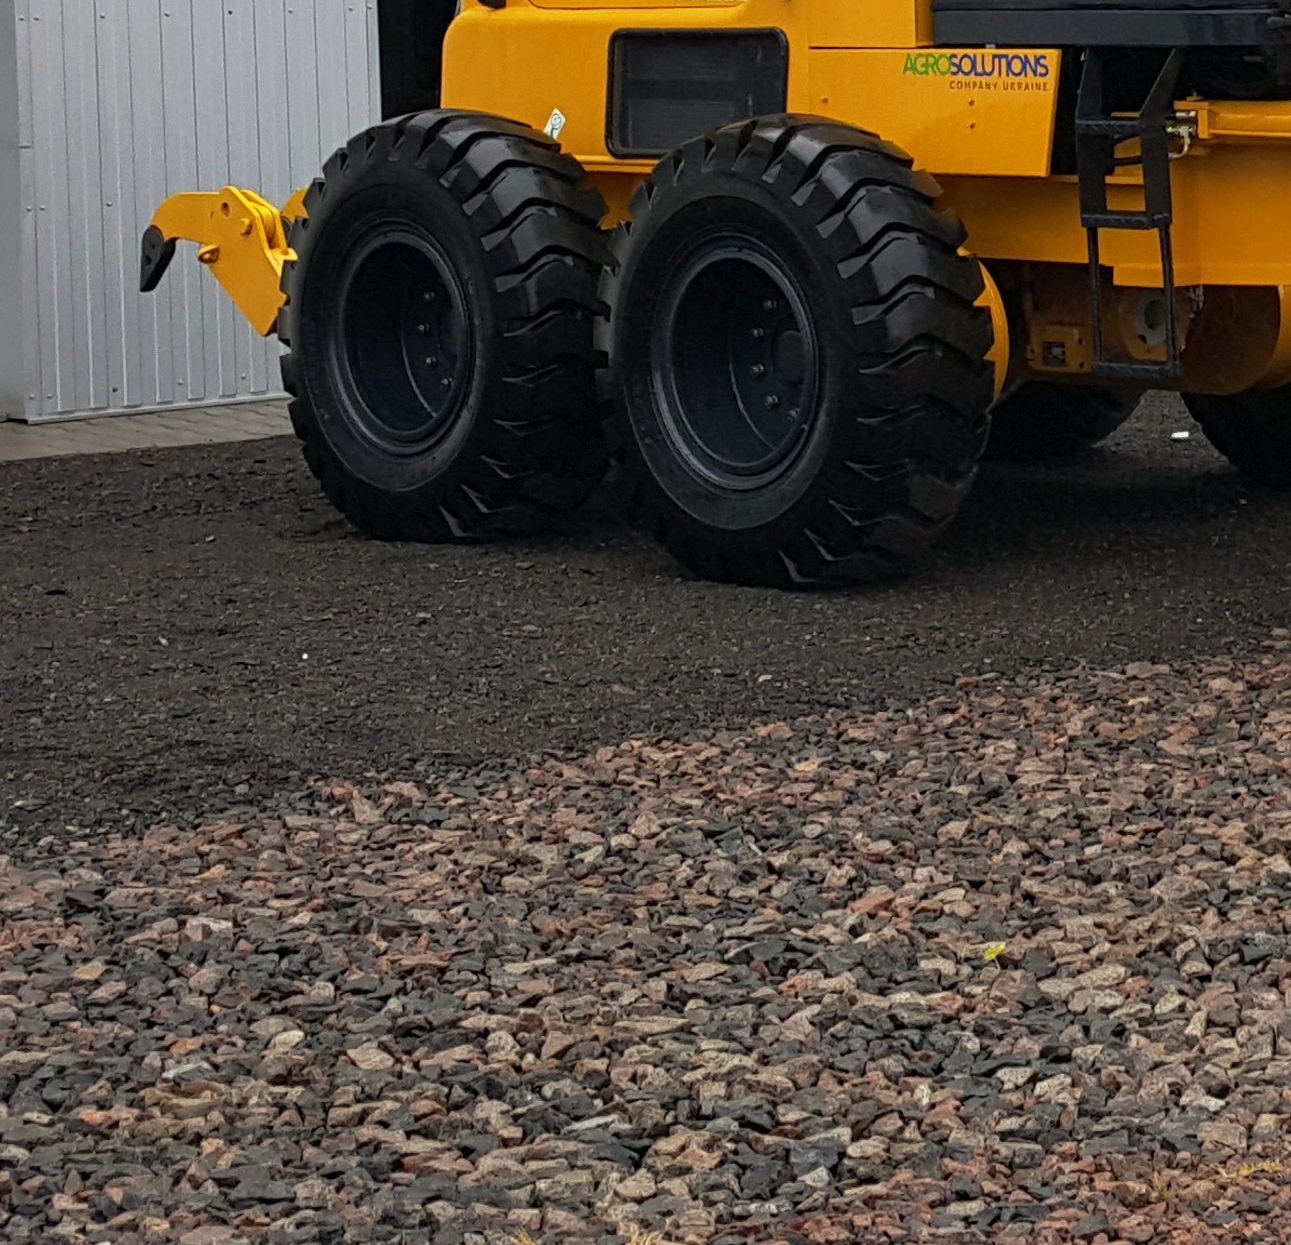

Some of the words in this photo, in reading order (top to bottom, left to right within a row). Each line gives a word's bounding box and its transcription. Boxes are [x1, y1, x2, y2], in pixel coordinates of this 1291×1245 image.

[903, 53, 1049, 77] AGROSOLUTIONS
[949, 80, 998, 91] COMPANY
[1003, 81, 1048, 91] UKRAINE
